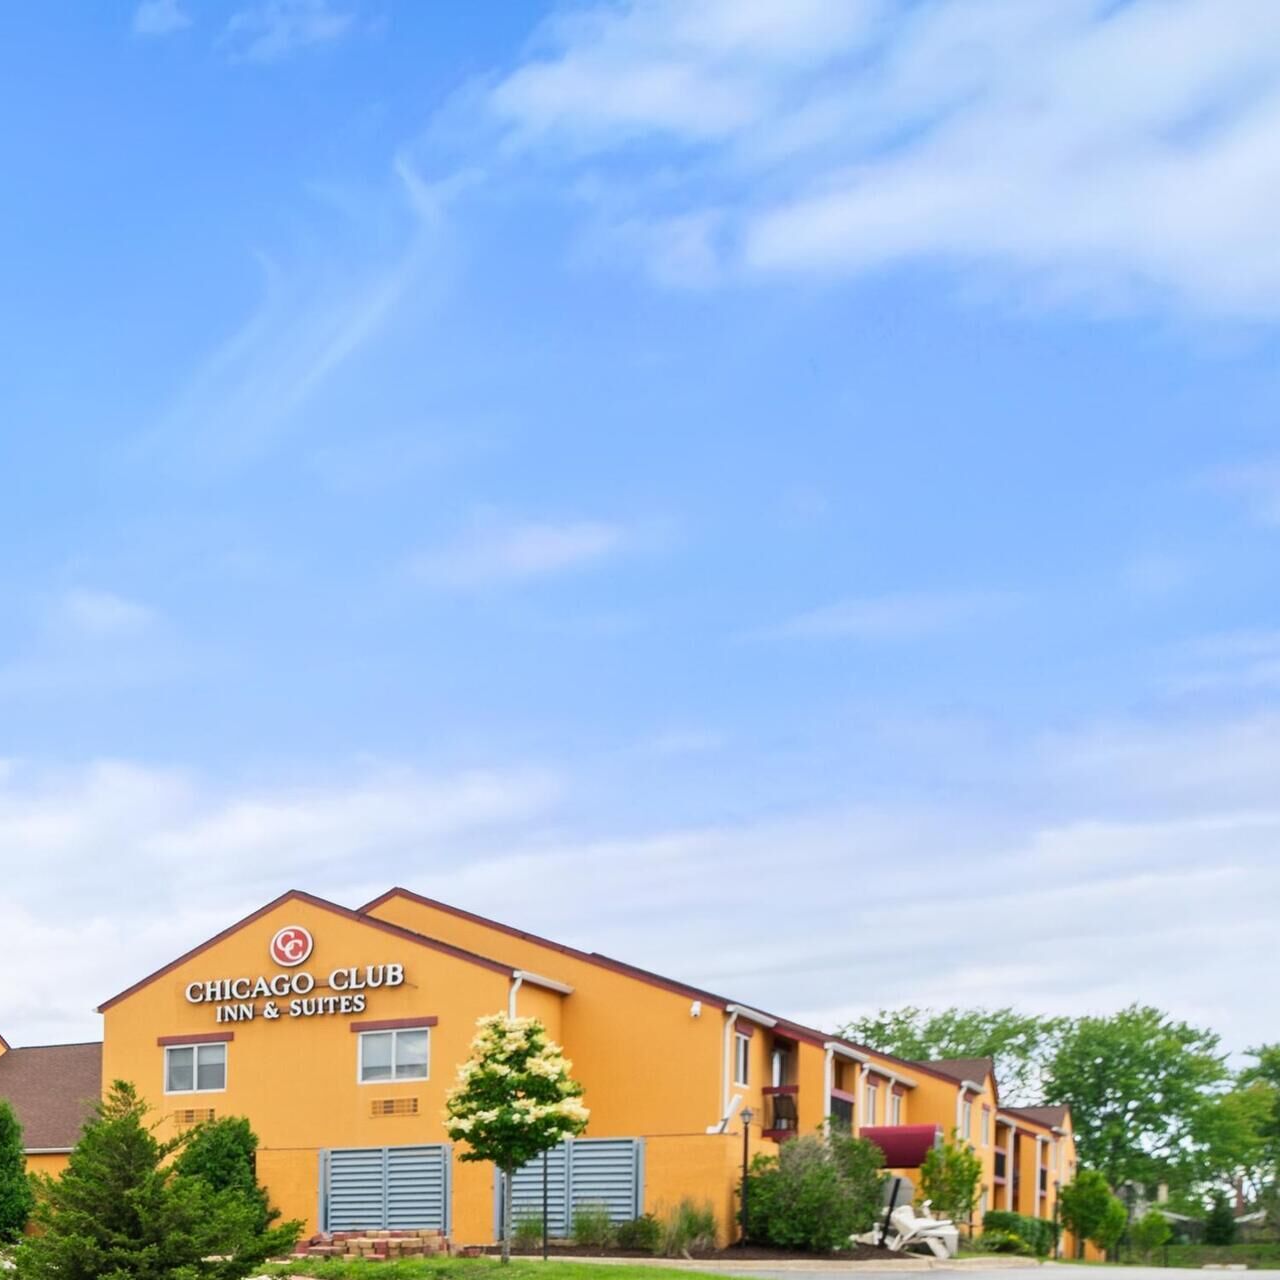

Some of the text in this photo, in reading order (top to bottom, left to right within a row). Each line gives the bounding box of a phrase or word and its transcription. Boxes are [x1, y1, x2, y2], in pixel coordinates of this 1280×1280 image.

[185, 963, 405, 1003] CHICAGO CLUB
[216, 994, 366, 1023] INN & SUITES
